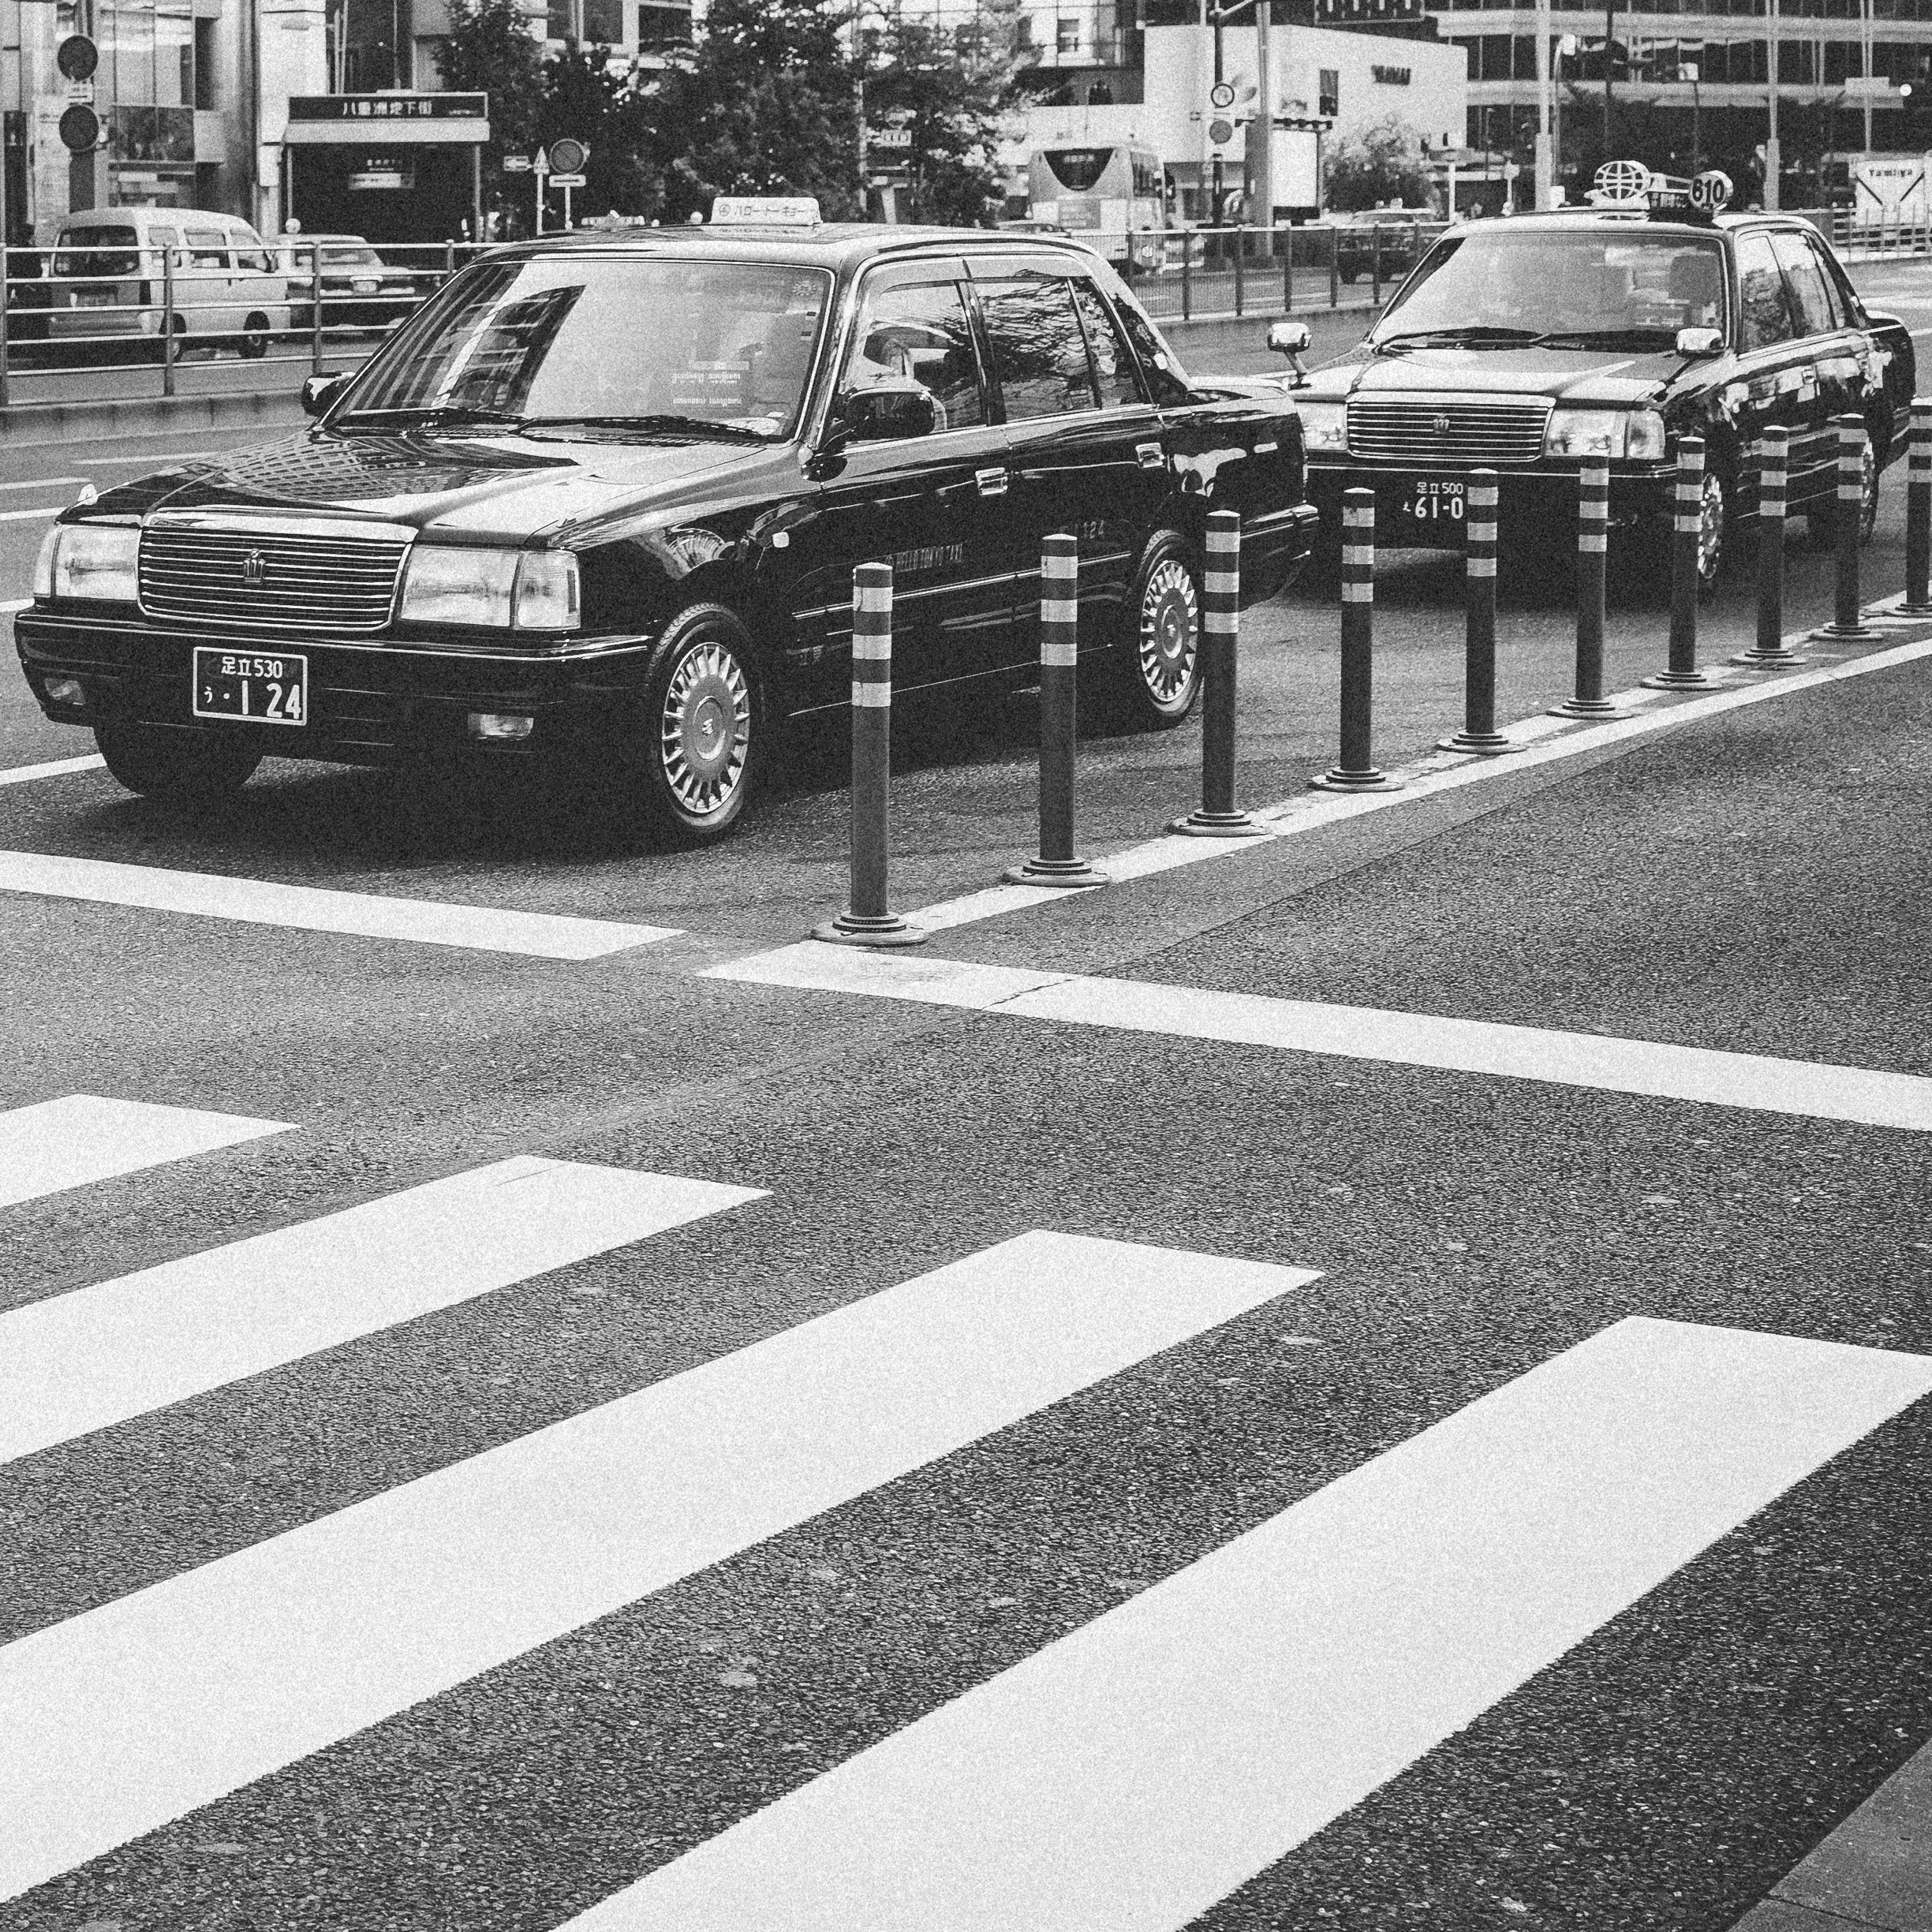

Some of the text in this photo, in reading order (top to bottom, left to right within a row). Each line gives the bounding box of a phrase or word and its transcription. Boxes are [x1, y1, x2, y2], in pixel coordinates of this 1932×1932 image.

[342, 101, 432, 116] 八重洲地下街
[1692, 178, 1725, 203] 610
[1416, 481, 1463, 495] 足立500
[221, 656, 283, 678] 足立530
